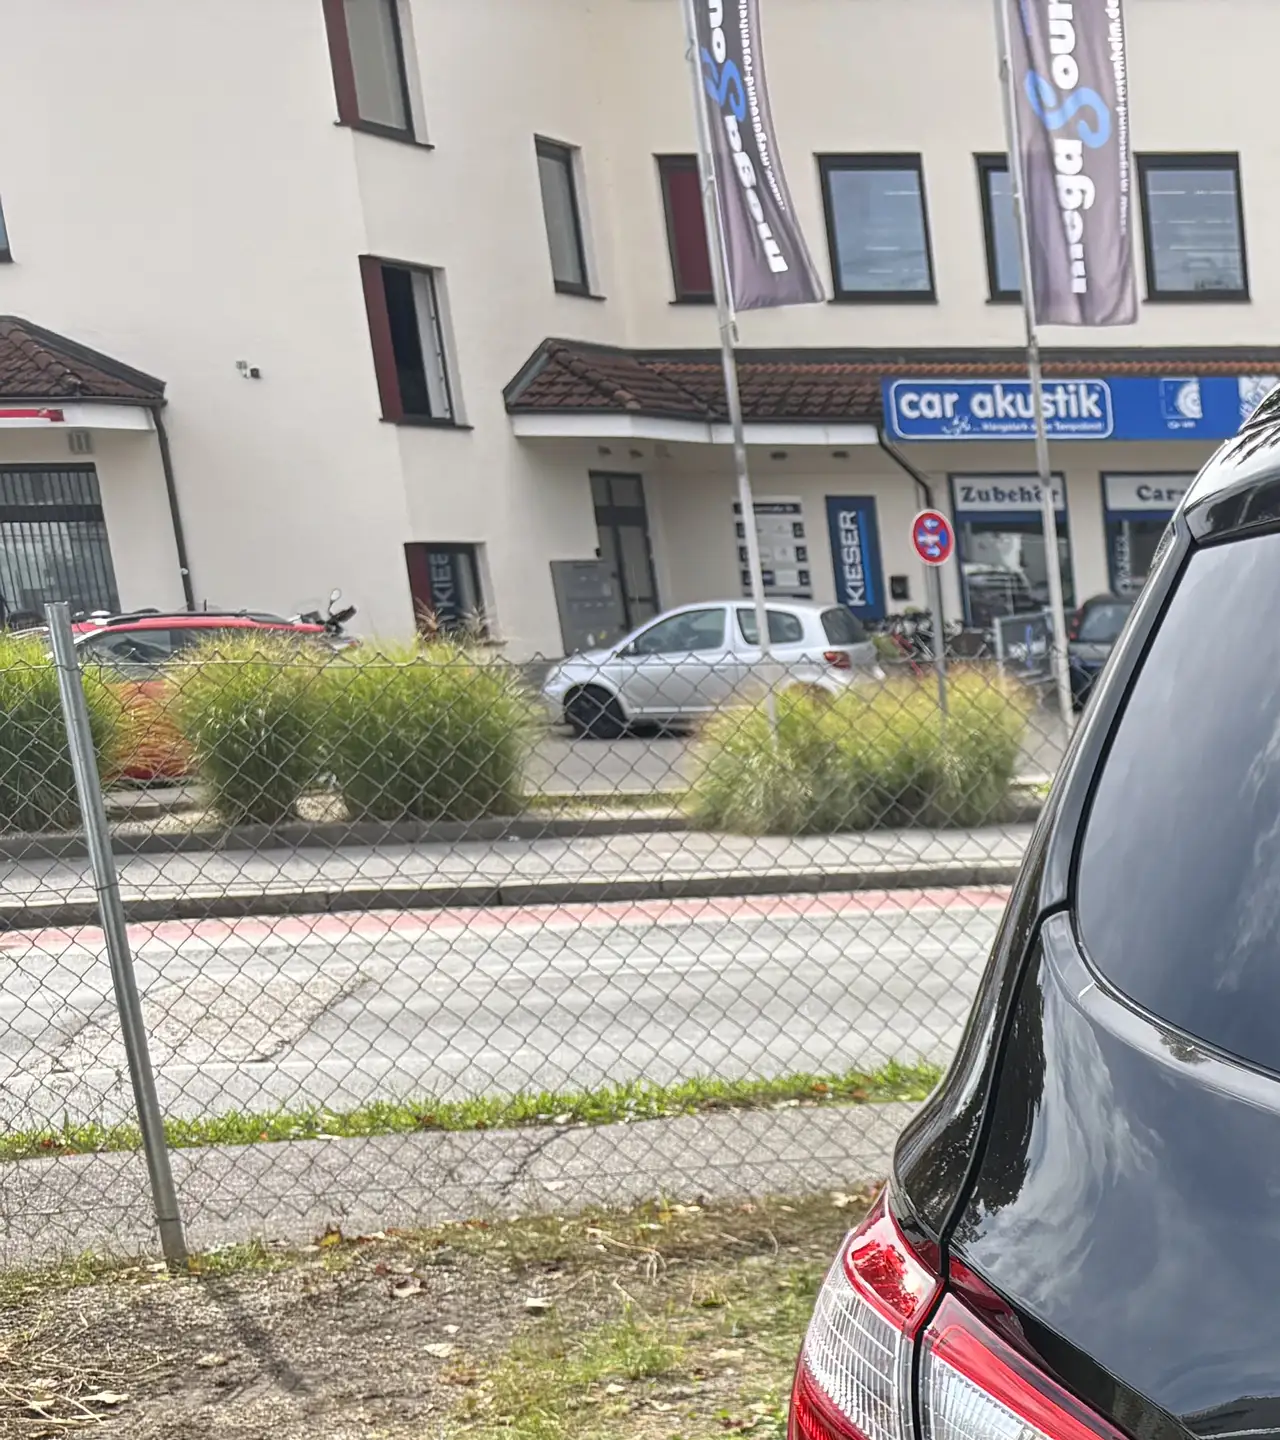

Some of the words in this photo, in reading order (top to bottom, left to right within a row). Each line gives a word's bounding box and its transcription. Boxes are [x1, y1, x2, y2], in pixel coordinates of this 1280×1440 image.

[901, 391, 960, 419] car
[970, 384, 1102, 419] akustik
[837, 510, 867, 607] KIESER
